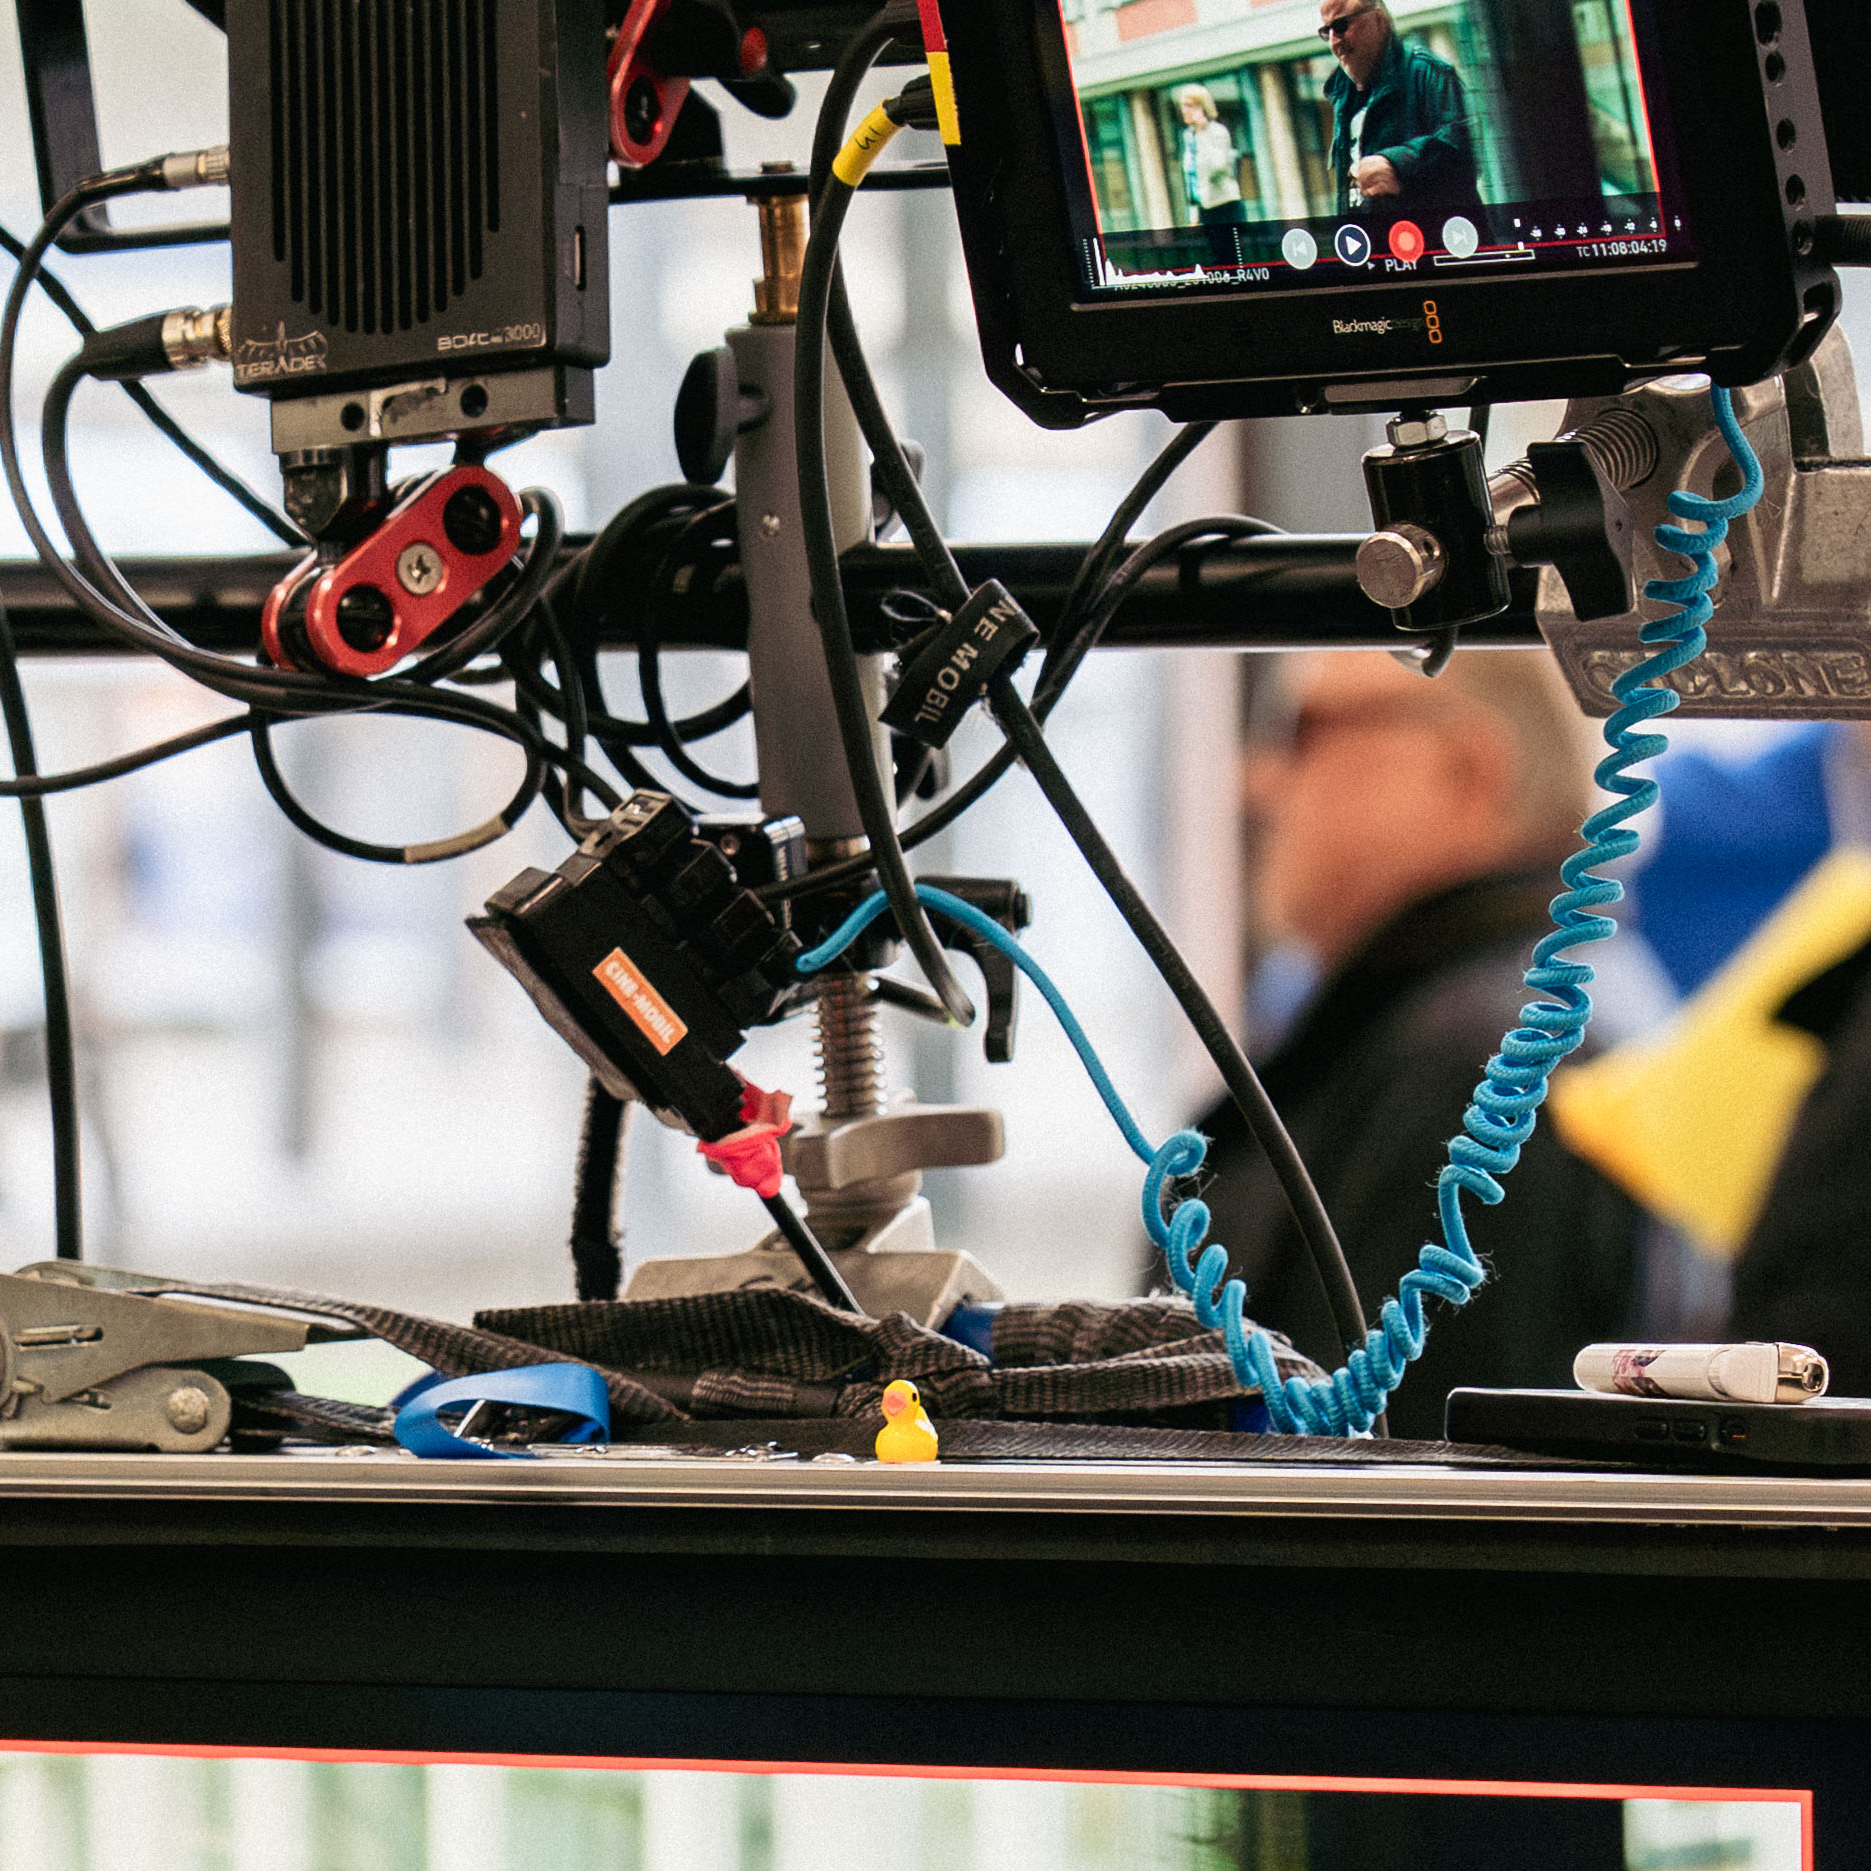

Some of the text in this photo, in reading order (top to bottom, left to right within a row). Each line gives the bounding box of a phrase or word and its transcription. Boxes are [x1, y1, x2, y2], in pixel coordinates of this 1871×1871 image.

[1576, 239, 1667, 258] TC 11:08:04:19
[236, 354, 327, 378] TERADEK
[914, 642, 978, 723] MOBIL
